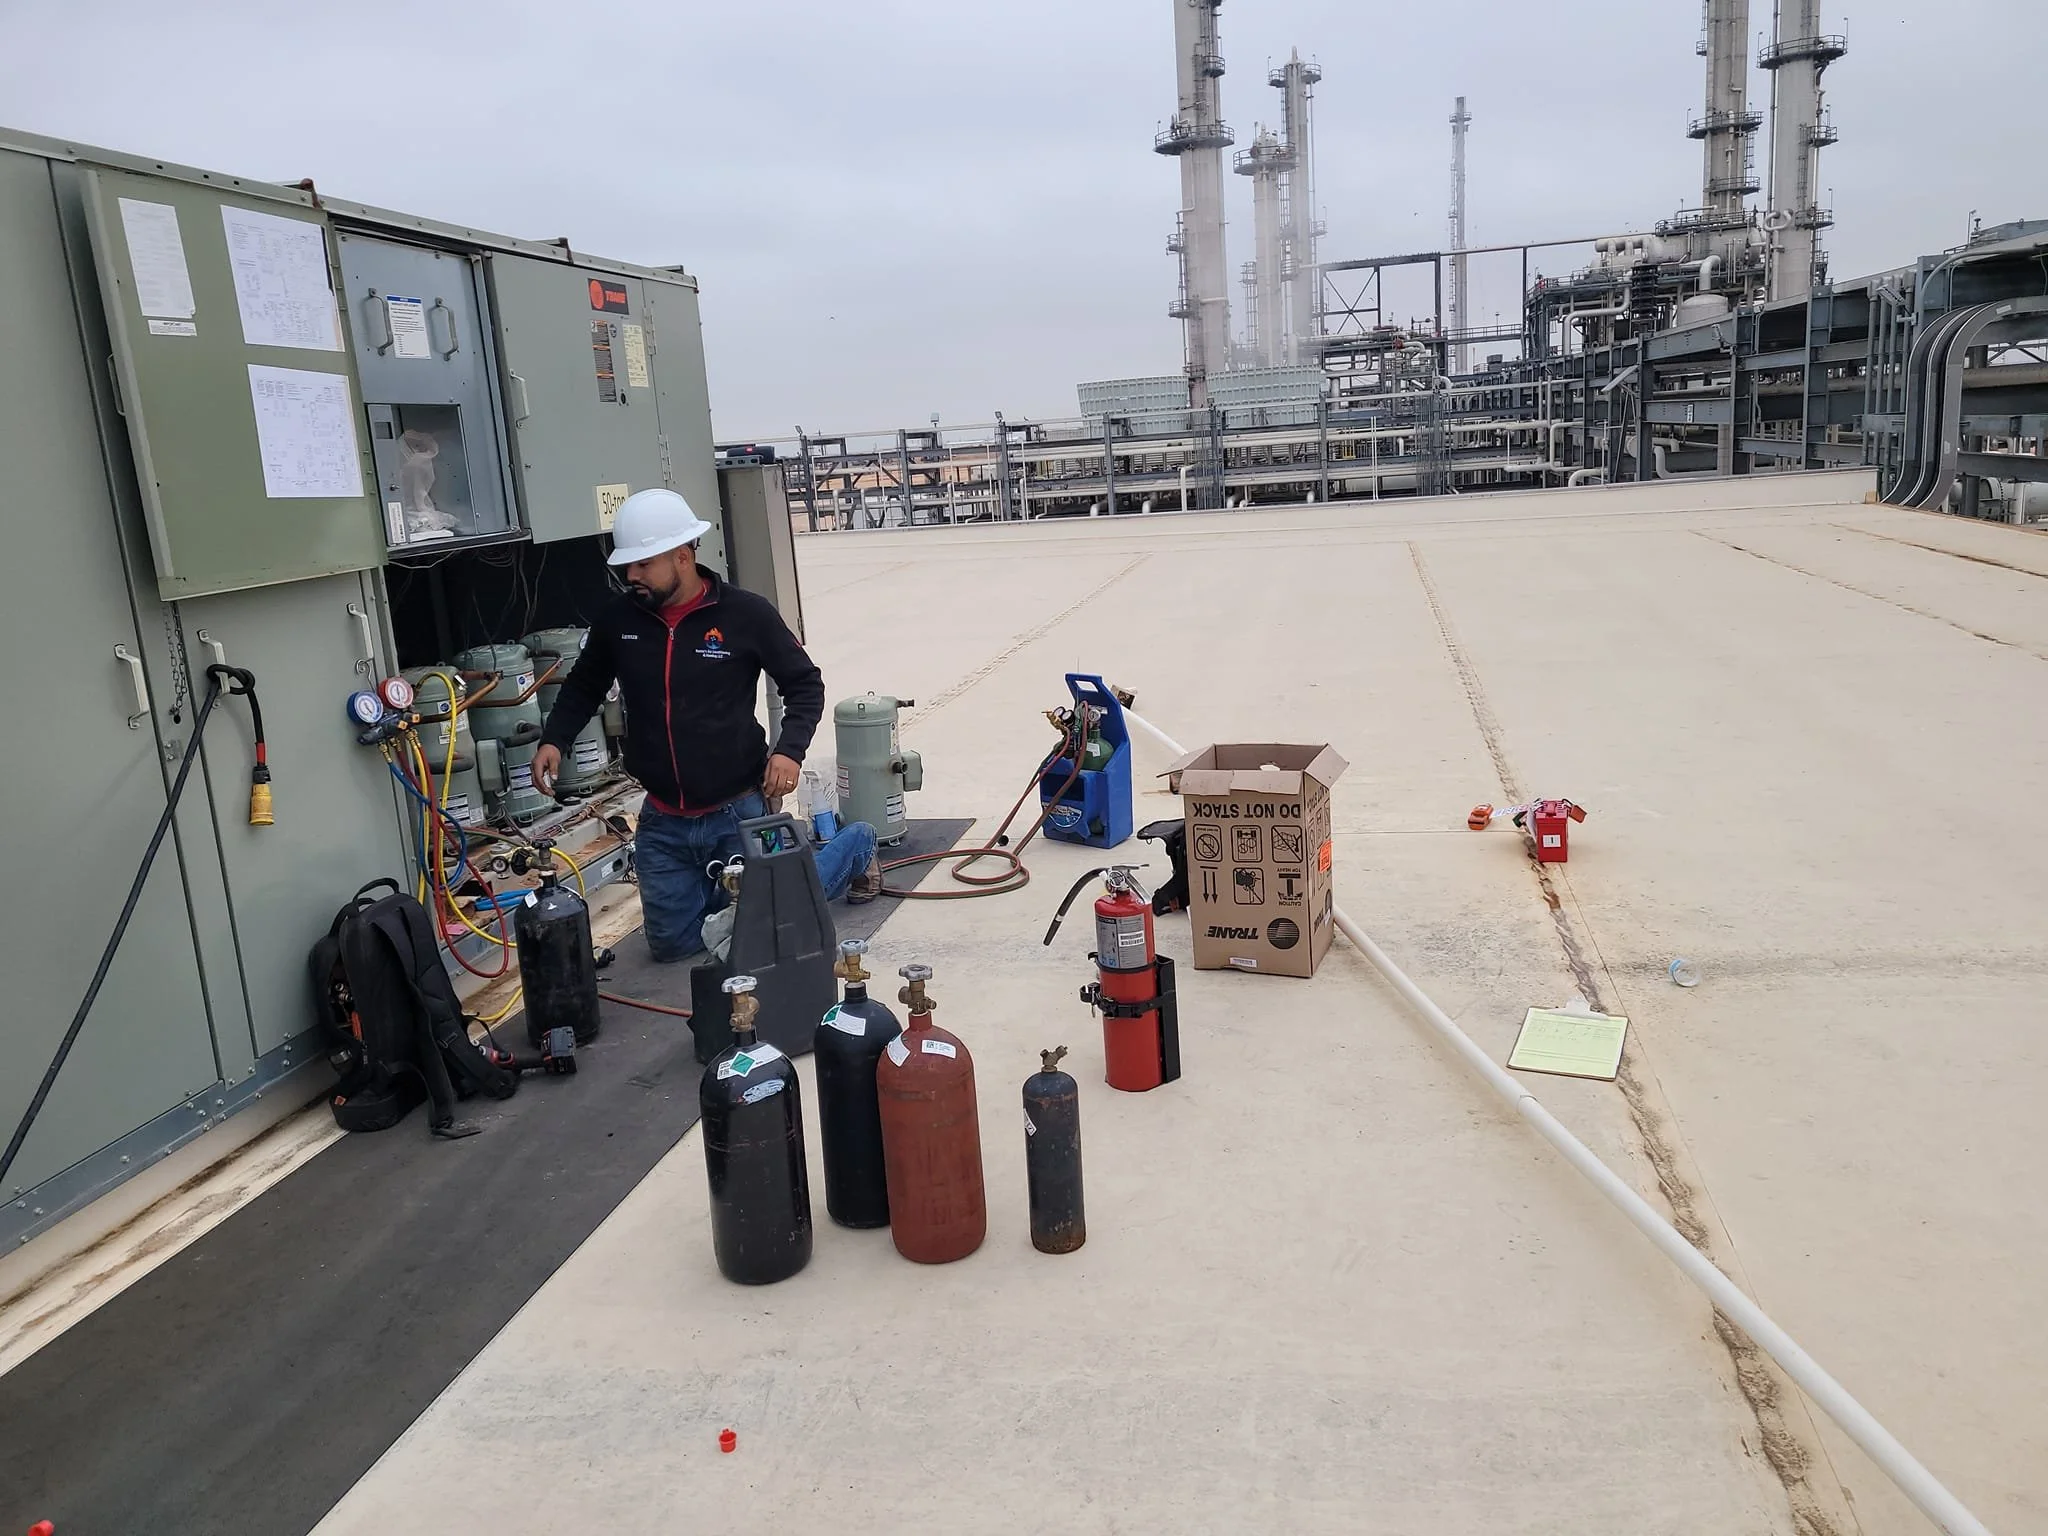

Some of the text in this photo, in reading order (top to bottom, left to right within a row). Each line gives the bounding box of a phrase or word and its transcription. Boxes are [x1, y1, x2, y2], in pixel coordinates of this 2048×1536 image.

[1192, 802, 1301, 819] DO NOT STACK
[1207, 925, 1259, 940] TRANE
